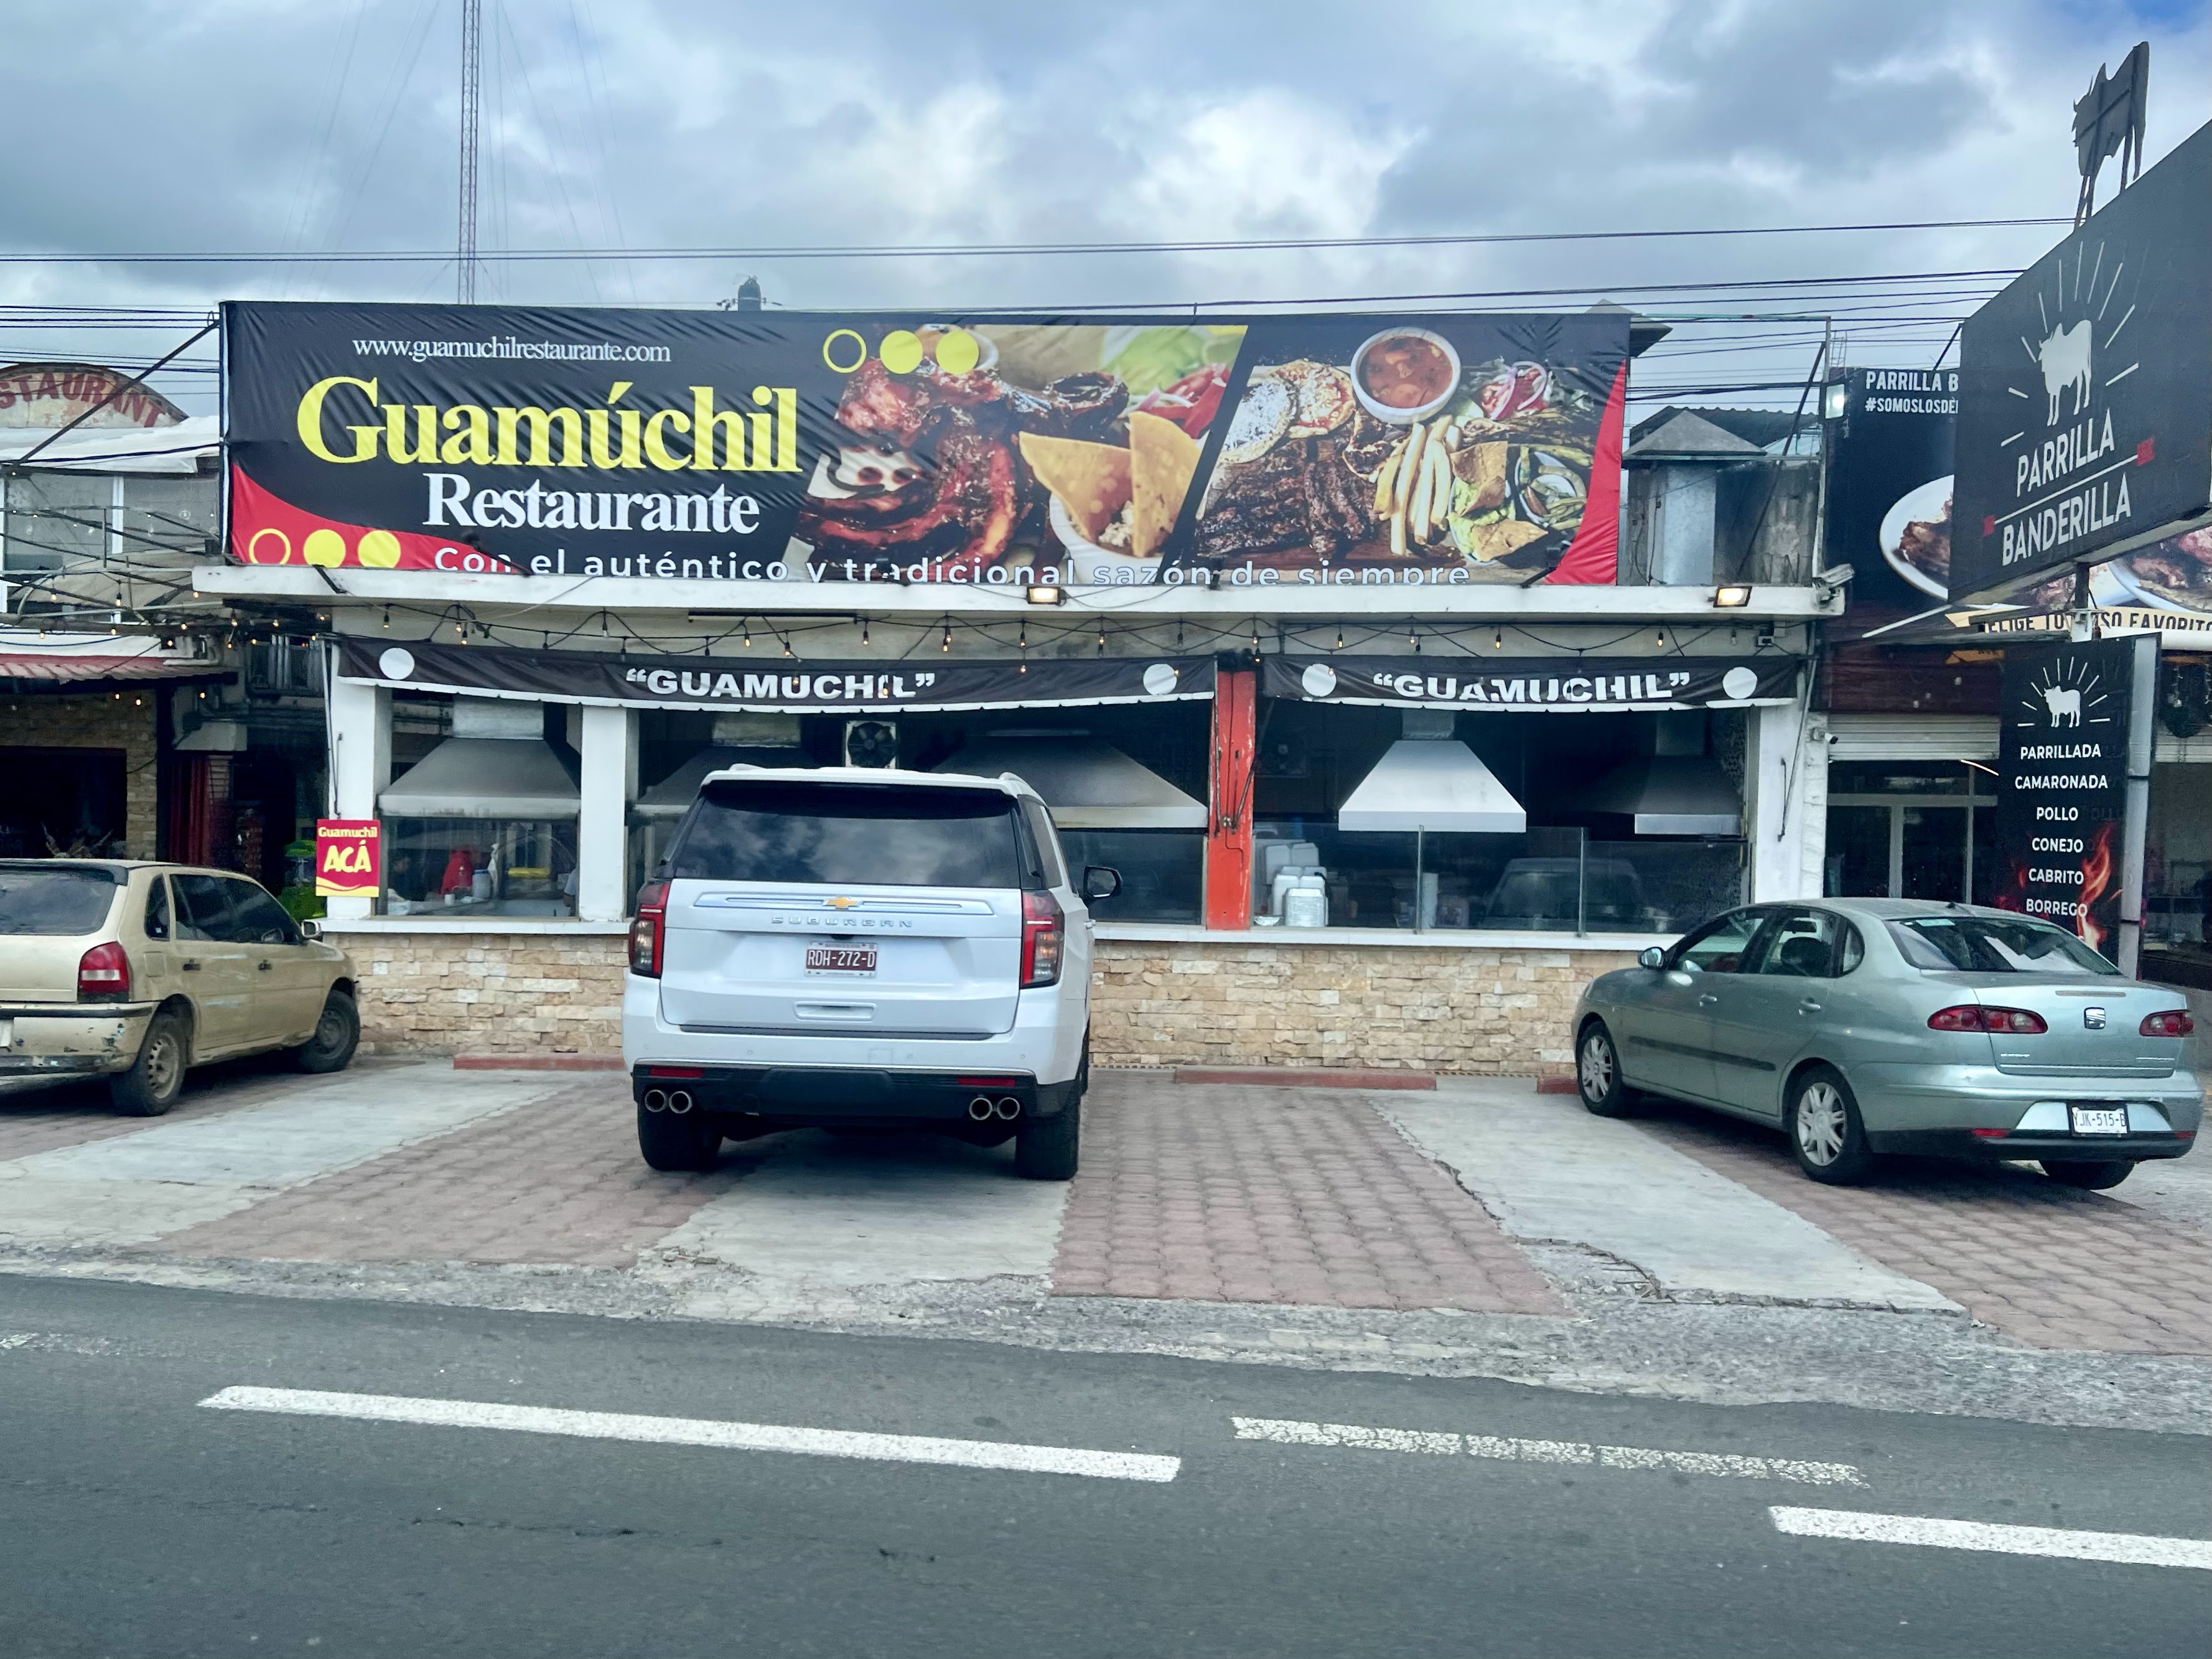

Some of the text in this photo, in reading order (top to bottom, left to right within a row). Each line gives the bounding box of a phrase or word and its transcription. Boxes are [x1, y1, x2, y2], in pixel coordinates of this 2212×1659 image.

[352, 336, 671, 363] www.guamuchilrestaurante.com
[1865, 371, 1942, 391] PARRILLA
[297, 376, 803, 472] Guamúchil
[2017, 408, 2115, 498] PARRILLA
[422, 472, 760, 534] Restaurante
[2002, 472, 2131, 566] BANDERILLA
[434, 547, 511, 573] Con
[530, 548, 565, 574] el
[584, 551, 789, 581] auténtico
[844, 556, 1075, 584] tradicional
[1093, 560, 1211, 585] sazón
[1231, 561, 1280, 585] de
[1298, 559, 1470, 585] siempre
[2020, 744, 2102, 760] PARRILLADA
[2015, 774, 2108, 790] CAMARONADA
[2036, 806, 2079, 821] POLLO
[318, 826, 378, 838] Guamuchil
[2032, 838, 2084, 853] CONEJO
[323, 839, 372, 873] ACÁ
[2028, 867, 2084, 885] CABRITO
[2026, 898, 2088, 917] BORREGO
[772, 915, 913, 928] SUBURBAN
[807, 950, 875, 968] RDH-272-D
